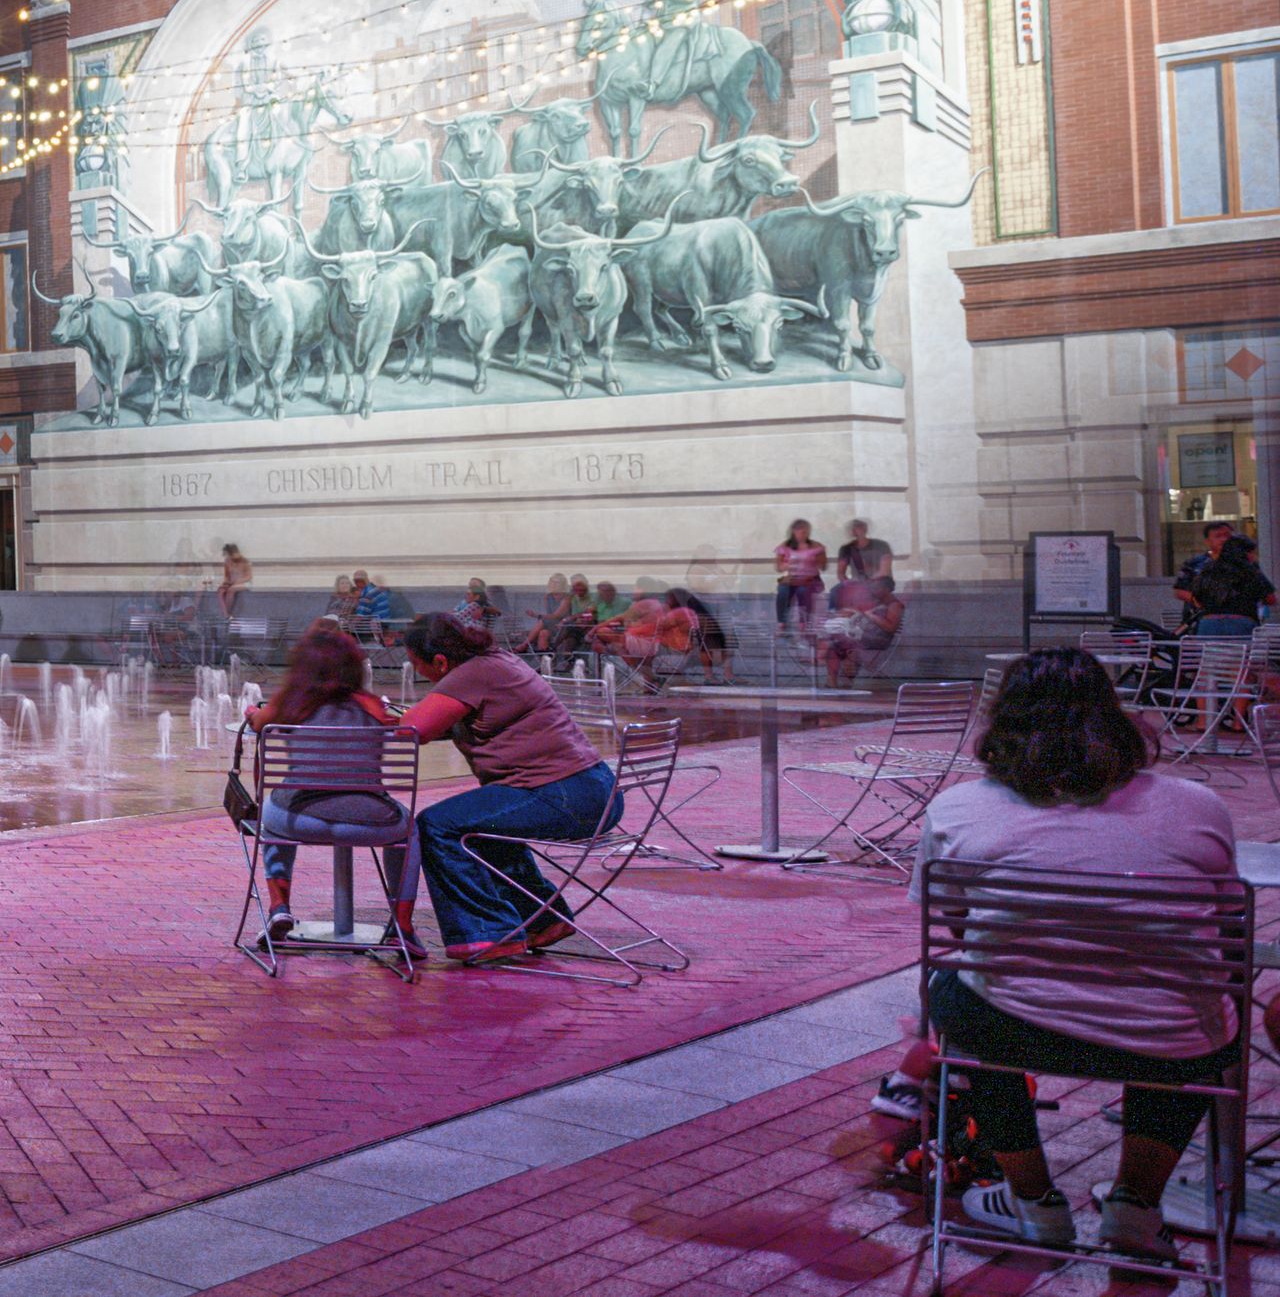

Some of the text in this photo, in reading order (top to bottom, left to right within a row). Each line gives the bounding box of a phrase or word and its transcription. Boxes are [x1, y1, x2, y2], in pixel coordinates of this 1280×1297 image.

[161, 452, 644, 498] 1867 CHISHOLM TRAIL 1875
